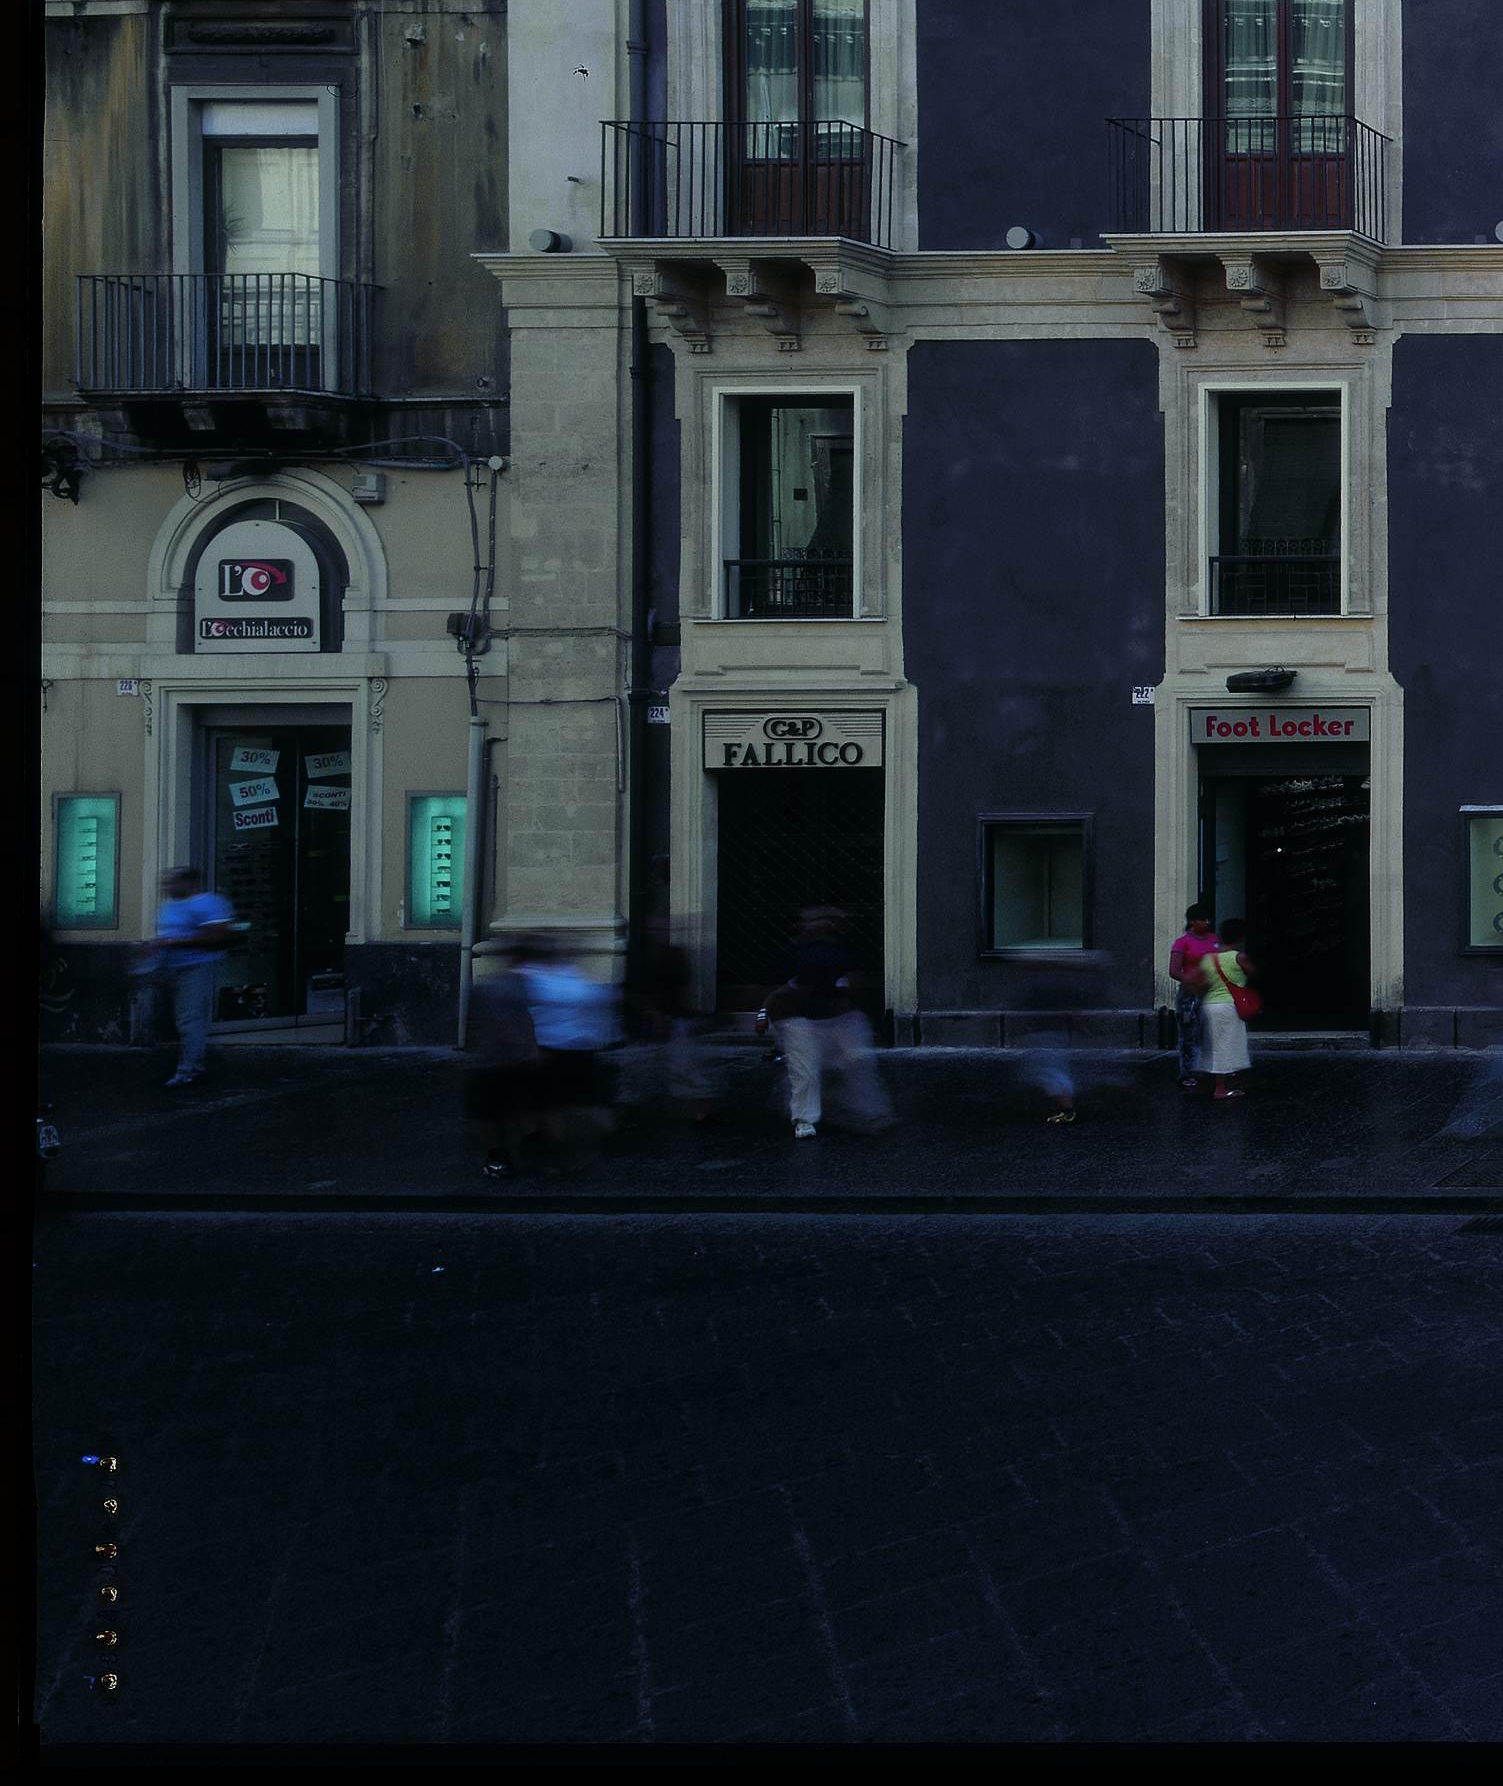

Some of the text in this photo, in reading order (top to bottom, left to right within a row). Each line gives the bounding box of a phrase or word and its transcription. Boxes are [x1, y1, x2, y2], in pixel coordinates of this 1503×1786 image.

[201, 620, 308, 638] L'Occhialaccio
[769, 720, 815, 737] G&P
[1205, 714, 1355, 737] Foot Locker
[240, 751, 271, 765] 30%
[312, 755, 344, 770] 30%
[722, 742, 864, 766] FALLICO
[239, 782, 271, 799] 50%
[235, 808, 274, 827] Sconti
